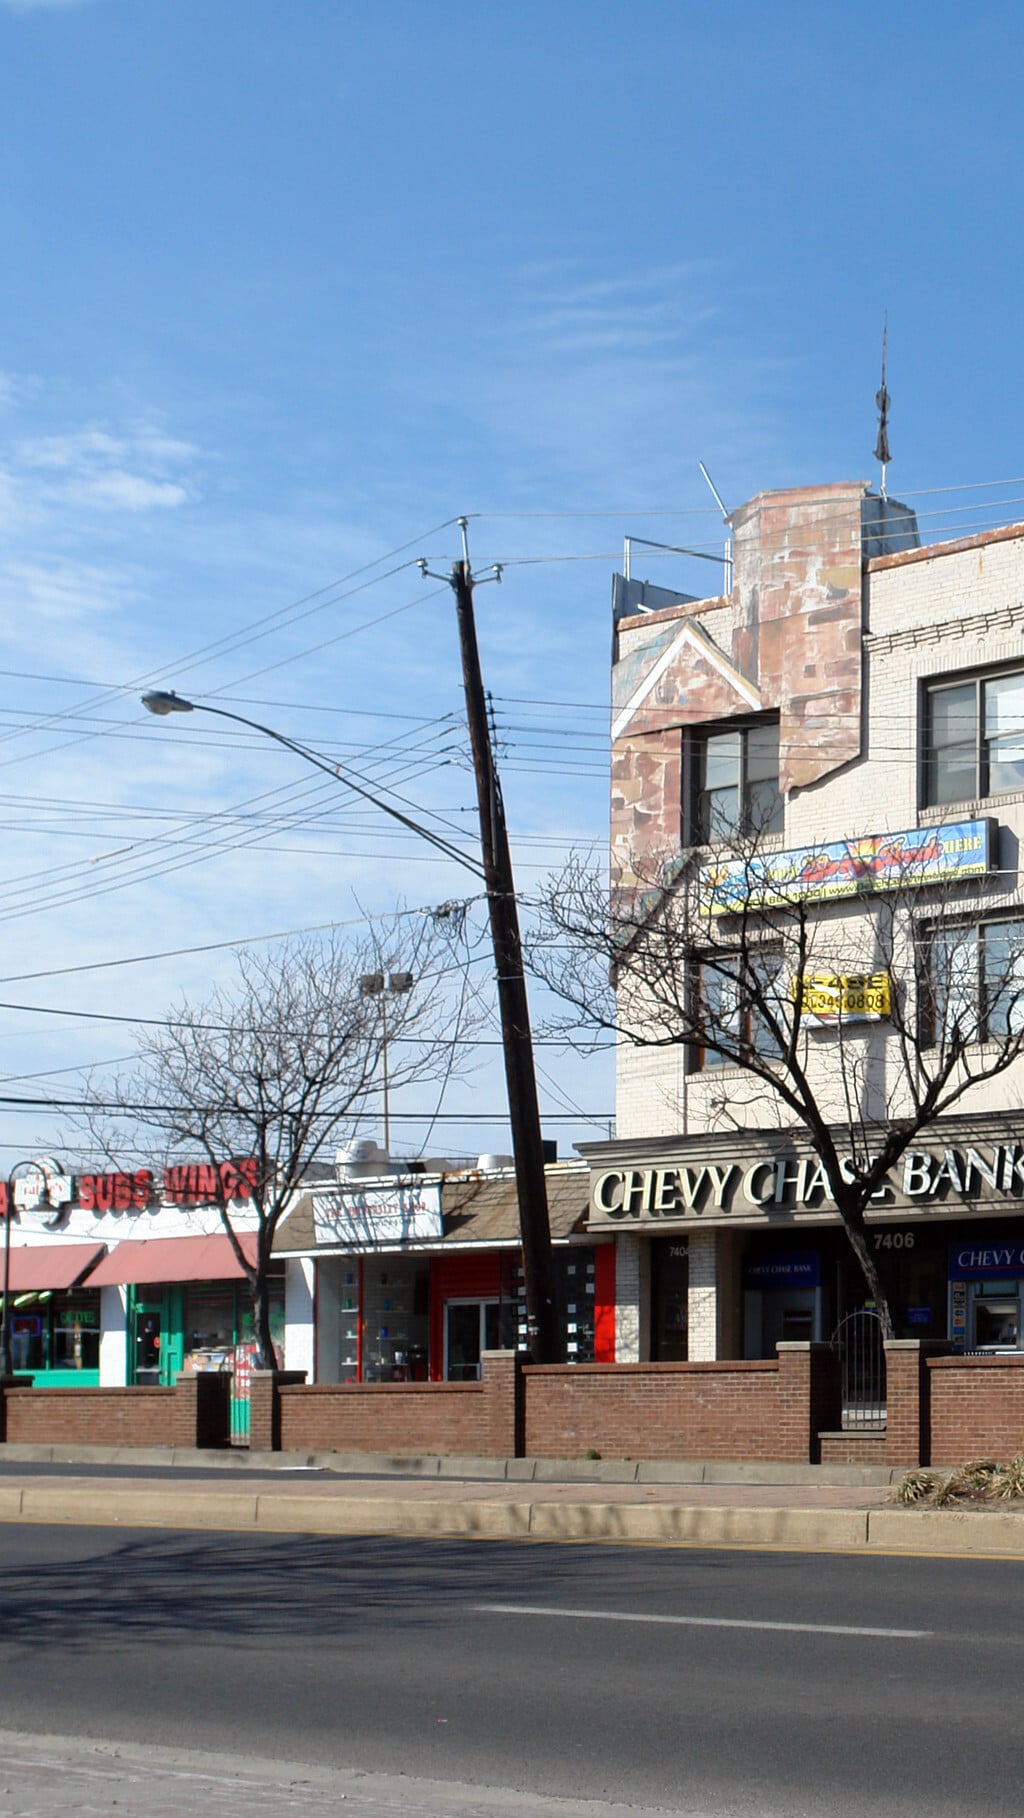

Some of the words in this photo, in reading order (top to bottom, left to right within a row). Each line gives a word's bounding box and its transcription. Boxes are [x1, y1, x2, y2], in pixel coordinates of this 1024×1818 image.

[943, 835, 982, 855] HERE
[80, 1169, 151, 1210] SUBS
[164, 1158, 258, 1204] WINGS
[593, 1164, 734, 1213] CHEVY
[873, 1232, 915, 1250] 7406
[958, 1248, 1015, 1267] CHEVY
